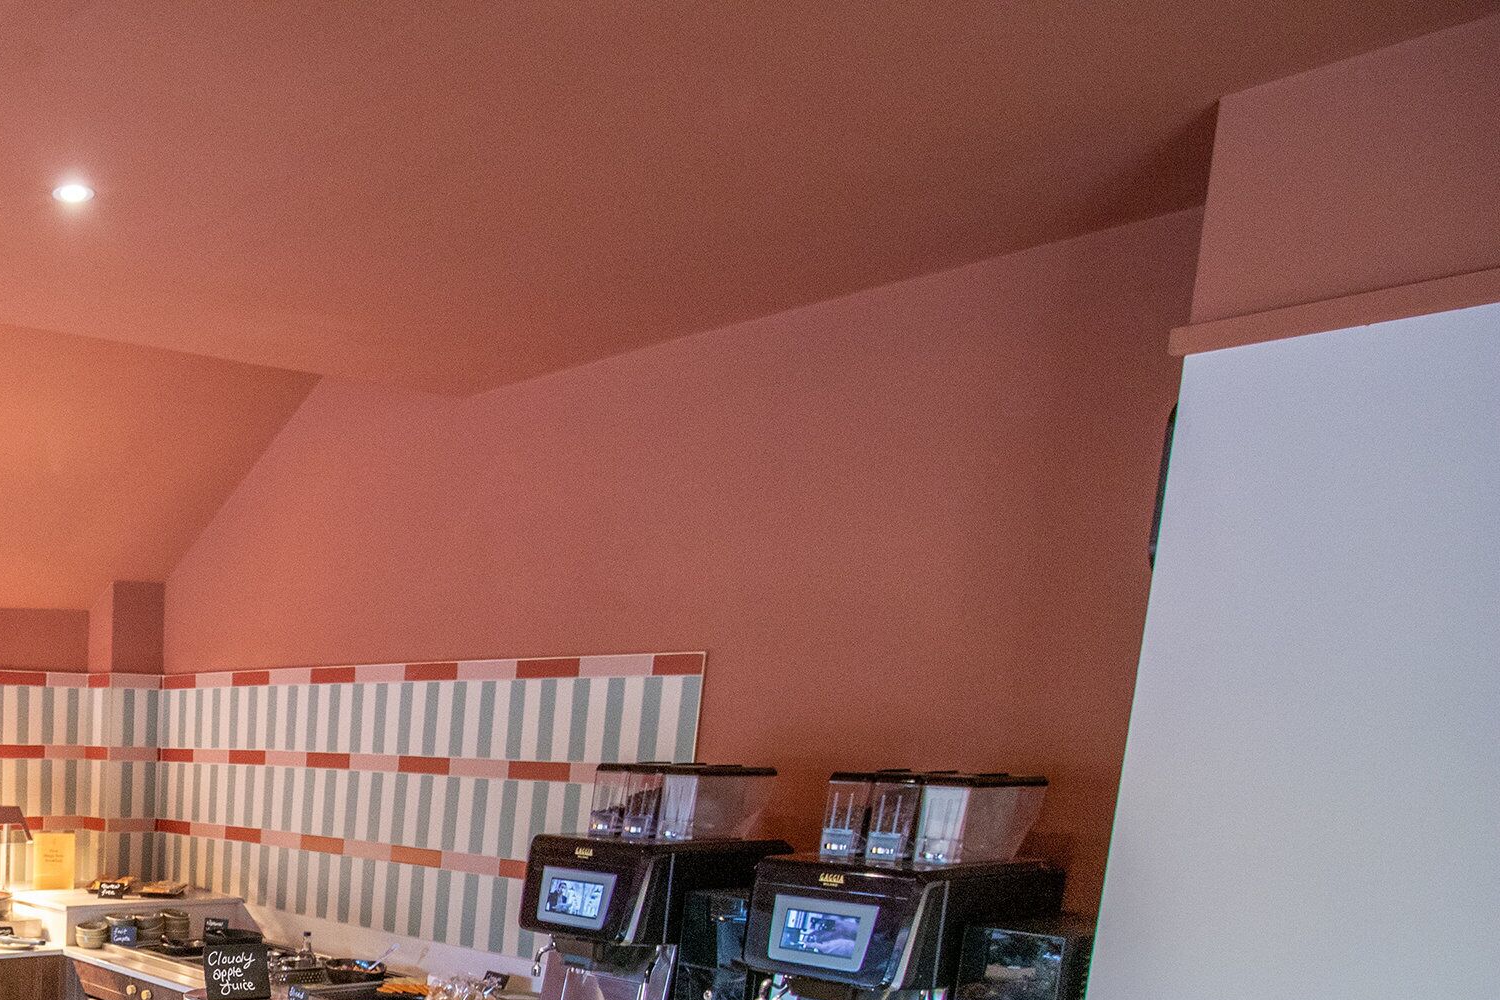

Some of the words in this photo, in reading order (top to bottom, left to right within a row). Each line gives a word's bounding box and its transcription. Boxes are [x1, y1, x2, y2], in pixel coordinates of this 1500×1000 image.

[819, 872, 844, 884] GAGGIA
[207, 950, 256, 970] Cloudy
[212, 966, 244, 981] apple
[219, 979, 256, 996] Juice
